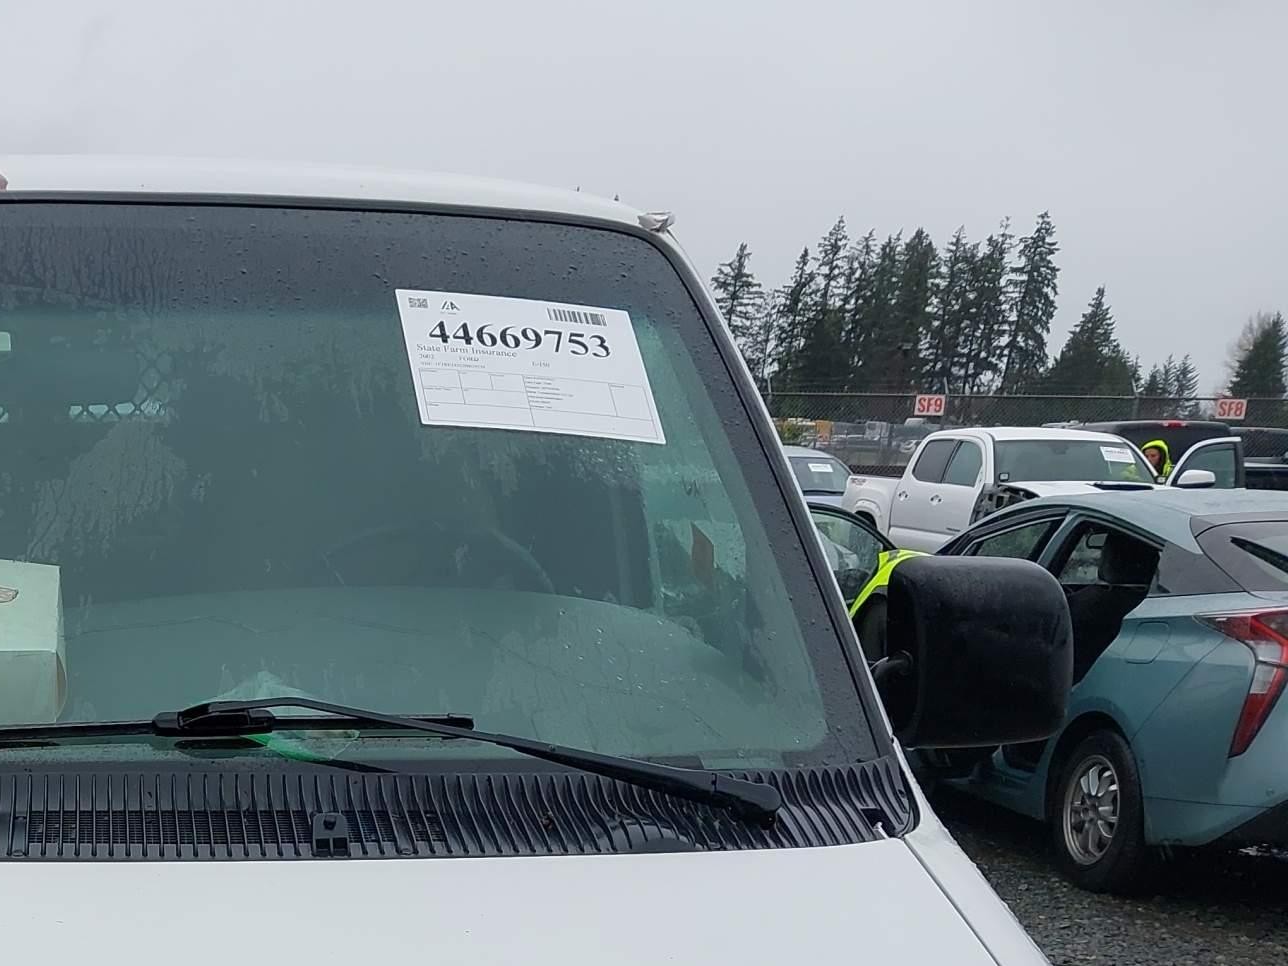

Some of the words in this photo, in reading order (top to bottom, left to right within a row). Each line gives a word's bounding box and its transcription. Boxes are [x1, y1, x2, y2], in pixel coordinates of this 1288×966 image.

[429, 320, 611, 359] 44669753
[416, 344, 440, 353] State
[443, 346, 469, 354] Farm
[471, 347, 517, 358] Insurance
[917, 396, 943, 414] SF9
[1218, 401, 1244, 418] SF8
